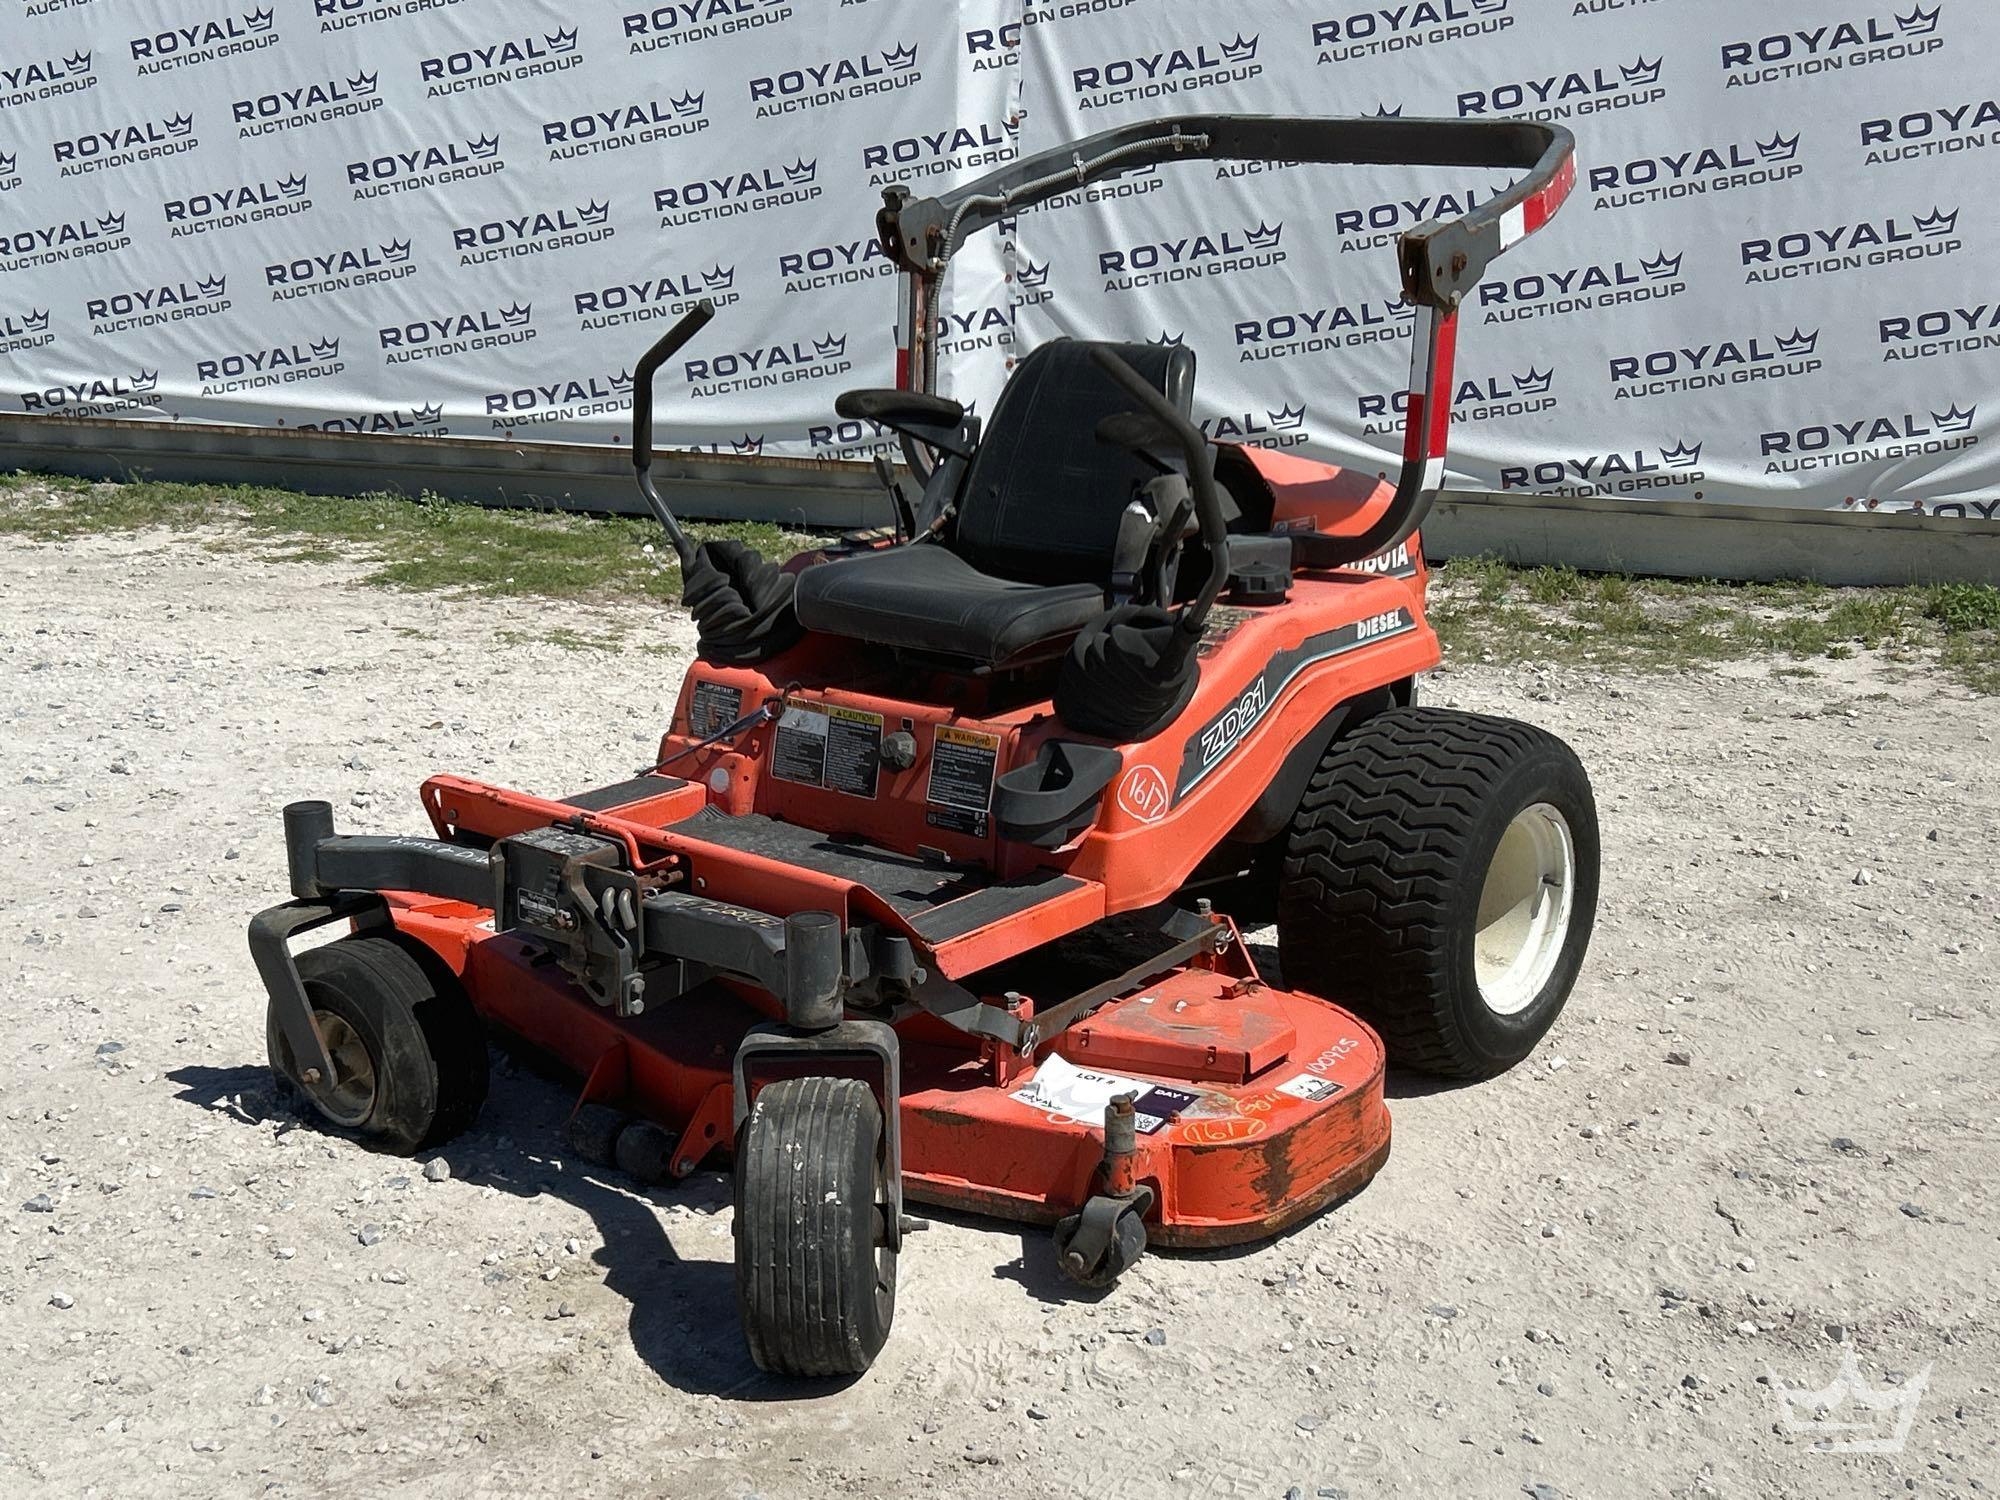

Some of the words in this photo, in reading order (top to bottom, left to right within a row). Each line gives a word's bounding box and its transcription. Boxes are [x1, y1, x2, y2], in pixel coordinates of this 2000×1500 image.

[130, 17, 246, 60] ROYAL
[320, 5, 401, 33] AUCTION
[629, 24, 718, 55] AUCTION
[722, 7, 792, 34] GROUP
[1312, 0, 1469, 47] ROYAL
[137, 48, 214, 77] AUCTION
[217, 33, 279, 58] GROUP
[420, 38, 547, 82] ROYAL
[1317, 33, 1423, 65] AUCTION
[1428, 16, 1514, 44] GROUP
[1721, 18, 1895, 69] ROYAL
[0, 60, 66, 90] YAL
[427, 70, 512, 99] AUCTION
[515, 54, 583, 79] GROUP
[749, 55, 884, 102] ROYAL
[1073, 45, 1220, 93] ROYAL
[1726, 55, 1843, 89] AUCTION
[1848, 38, 1944, 66] GROUP
[38, 76, 97, 100] GROUP
[232, 81, 349, 123] ROYAL
[756, 88, 845, 119] AUCTION
[849, 72, 921, 98] GROUP
[1078, 80, 1178, 111] AUCTION
[1182, 64, 1263, 90] GROUP
[1457, 68, 1619, 117] ROYAL
[1576, 88, 1666, 115] GROUP
[239, 112, 317, 139] AUCTION
[320, 98, 383, 121] GROUP
[542, 101, 672, 145] ROYAL
[53, 122, 166, 163] ROYAL
[60, 152, 135, 178] AUCTION
[138, 138, 198, 161] GROUP
[549, 133, 636, 162] AUCTION
[639, 118, 709, 143] GROUP
[863, 124, 1003, 169] ROYAL
[1864, 133, 1985, 166] AUCTION
[346, 144, 469, 185] ROYAL
[353, 174, 435, 201] AUCTION
[438, 161, 505, 184] GROUP
[868, 158, 963, 188] AUCTION
[966, 147, 1018, 170] GRO
[1589, 144, 1755, 192] ROYAL
[164, 183, 279, 222] ROYAL
[653, 169, 785, 212] ROYAL
[660, 201, 748, 229] AUCTION
[752, 186, 822, 211] GROUP
[1086, 178, 1164, 204] GROUP
[1594, 180, 1706, 211] AUCTION
[1712, 164, 1803, 191] GROUP
[171, 212, 248, 238] AUCTION
[250, 200, 312, 222] GROUP
[453, 210, 578, 250] ROYAL
[0, 249, 70, 272] AUCTION
[72, 237, 131, 258] GROUP
[460, 241, 543, 267] AUCTION
[547, 227, 615, 250] GROUP
[779, 238, 885, 277] ROYA
[1099, 232, 1244, 275] ROYAL
[1339, 232, 1402, 254] AUCT
[1741, 219, 1912, 266] ROYAL
[1745, 257, 1862, 285] AUCTION
[1866, 240, 1962, 266] GROUP
[265, 248, 382, 286] ROYAL
[272, 277, 350, 302] AUCTION
[353, 265, 417, 286] GROUP
[784, 266, 875, 295] AUCTION
[1104, 265, 1202, 293] AUCTION
[1207, 251, 1286, 276] GROUP
[1479, 262, 1640, 307] ROYAL
[86, 283, 199, 320] ROYAL
[574, 274, 703, 315] ROYAL
[581, 306, 666, 331] AUCTION
[669, 292, 740, 316] GRUP
[1483, 296, 1592, 325] AUCTION
[1598, 282, 1686, 307] GROUP
[93, 311, 168, 336] AUCTION
[171, 300, 232, 321] GROUP
[379, 311, 501, 349] ROYAL
[1234, 303, 1385, 346] ROYAL
[196, 345, 312, 381] ROYAL
[386, 341, 468, 365] AUCTION
[471, 329, 537, 350] GROUP
[684, 342, 814, 383] ROYAL
[1240, 337, 1341, 363] AUCTION
[1345, 325, 1411, 347] GROU
[1609, 338, 1775, 382] ROYAL
[1883, 334, 2000, 362] AUCTION
[20, 378, 129, 411] ROYAL
[201, 374, 280, 397] AUCTION
[283, 362, 345, 383] GROUP
[485, 378, 610, 415] ROYAL
[691, 373, 778, 399] AUCTION
[781, 361, 851, 383] GROUP
[1358, 378, 1512, 419] ROAL
[1614, 372, 1726, 400] AUCTION
[1731, 359, 1822, 383] GROUP
[103, 394, 163, 413] GROUP
[491, 408, 574, 430] AUCTION
[577, 398, 632, 416] GROU
[1471, 397, 1557, 421] GROUP
[808, 418, 896, 447] ROY
[1760, 414, 1930, 456] ROYAL
[1501, 450, 1659, 489] ROYAL
[1763, 449, 1878, 475] AUCTION
[1885, 435, 1979, 459] GROUP
[1618, 471, 1705, 493] GROUP
[1356, 609, 1403, 640] DIESEL
[841, 710, 875, 725] CAUTION
[1201, 675, 1266, 766] ZD21
[953, 731, 991, 746] WARNING
[1076, 1072, 1105, 1083] LOT
[1154, 1088, 1179, 1099] DAY
